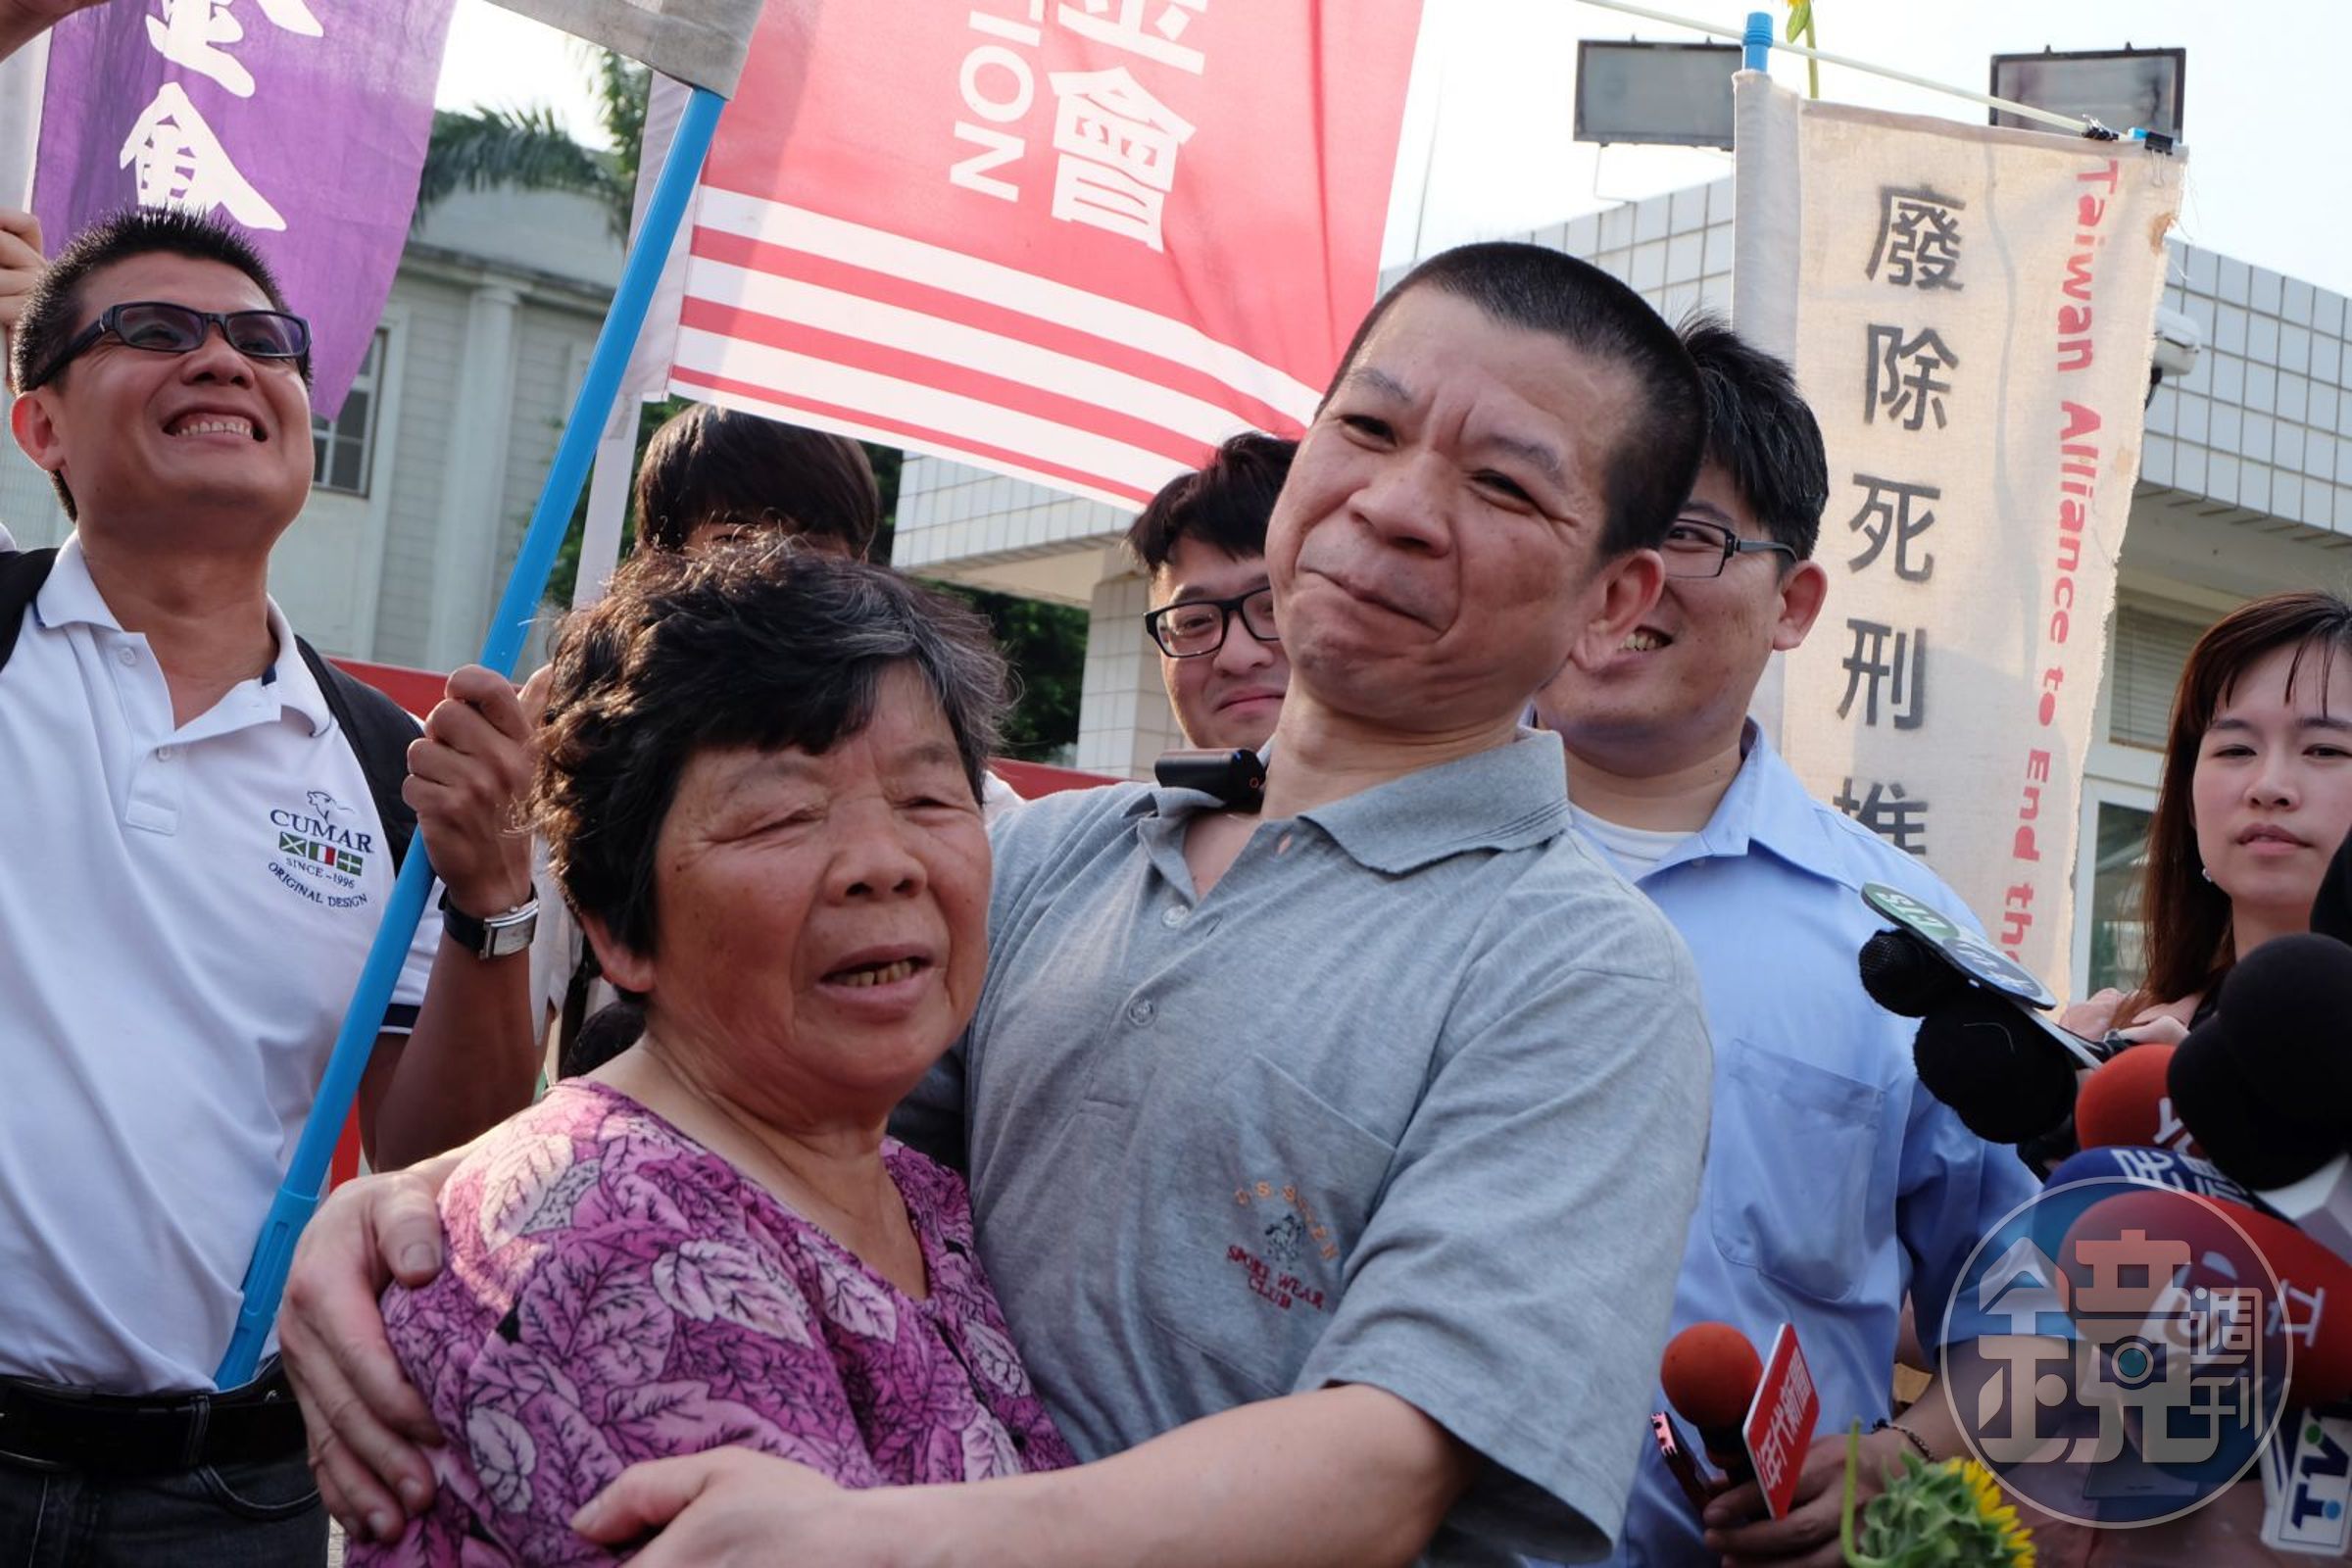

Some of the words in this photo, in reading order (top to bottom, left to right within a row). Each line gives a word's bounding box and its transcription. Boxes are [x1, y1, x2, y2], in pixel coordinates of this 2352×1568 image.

[951, 0, 1044, 202] ION
[2058, 159, 2120, 372] Taiwan
[2049, 400, 2101, 644] Alliance
[2038, 665, 2065, 726] to
[270, 808, 374, 854] CUMAR
[2013, 748, 2052, 862] End
[269, 861, 323, 904] ORIGINAL
[327, 893, 368, 908] DESIGN
[286, 857, 323, 878] SINCE
